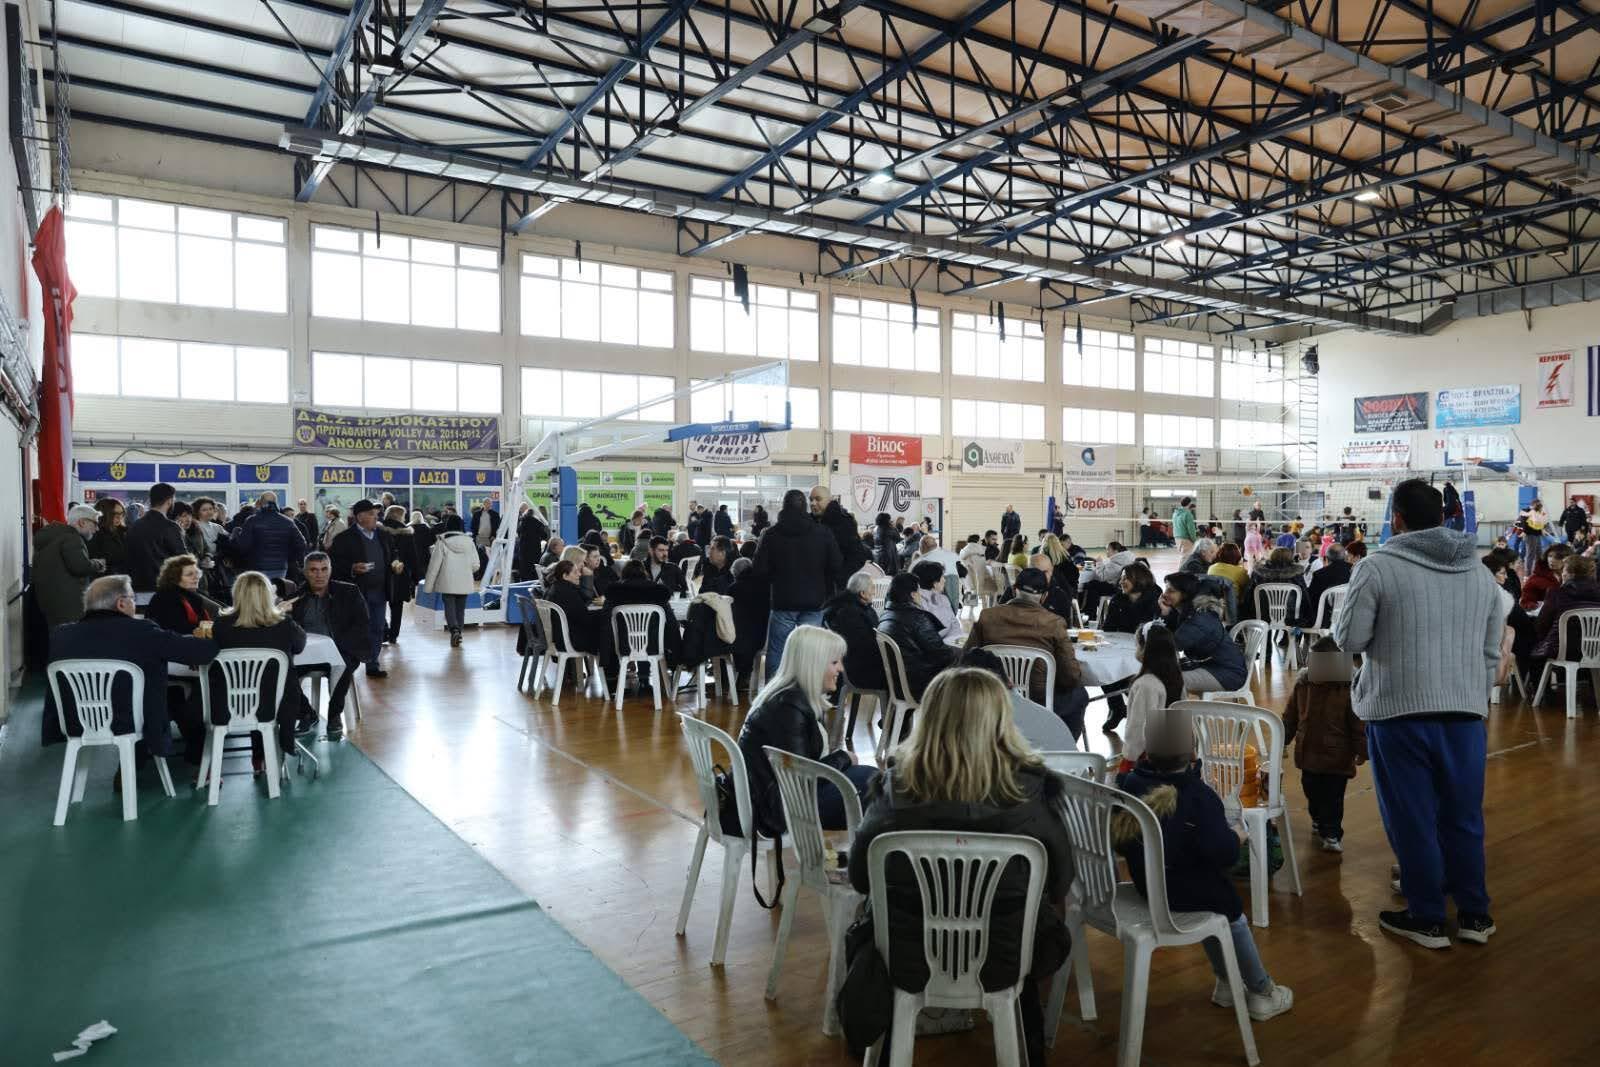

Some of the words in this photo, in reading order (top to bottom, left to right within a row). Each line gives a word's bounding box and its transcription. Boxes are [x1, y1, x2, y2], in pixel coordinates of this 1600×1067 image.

[1539, 354, 1570, 363] ΚΕΡΑΥΝΟΣ
[389, 427, 422, 438] VOLLEY
[440, 429, 481, 439] 2011-2012
[328, 437, 381, 449] ΑΝΟΔΟΣ
[407, 439, 469, 450] ΓΥΝΑΙΚΩΝ
[697, 444, 759, 455] ΝΙΑΝΙΑΣ
[867, 435, 905, 456] Βίκος
[177, 468, 216, 479] ΔΑΣΩ
[321, 469, 355, 483] ΔΑΣΩ
[419, 471, 449, 484] ΔΑΣΩ
[878, 477, 911, 513] 70
[900, 490, 921, 498] ΧΡΟΝΙΑ
[1075, 497, 1115, 511] TopGas
